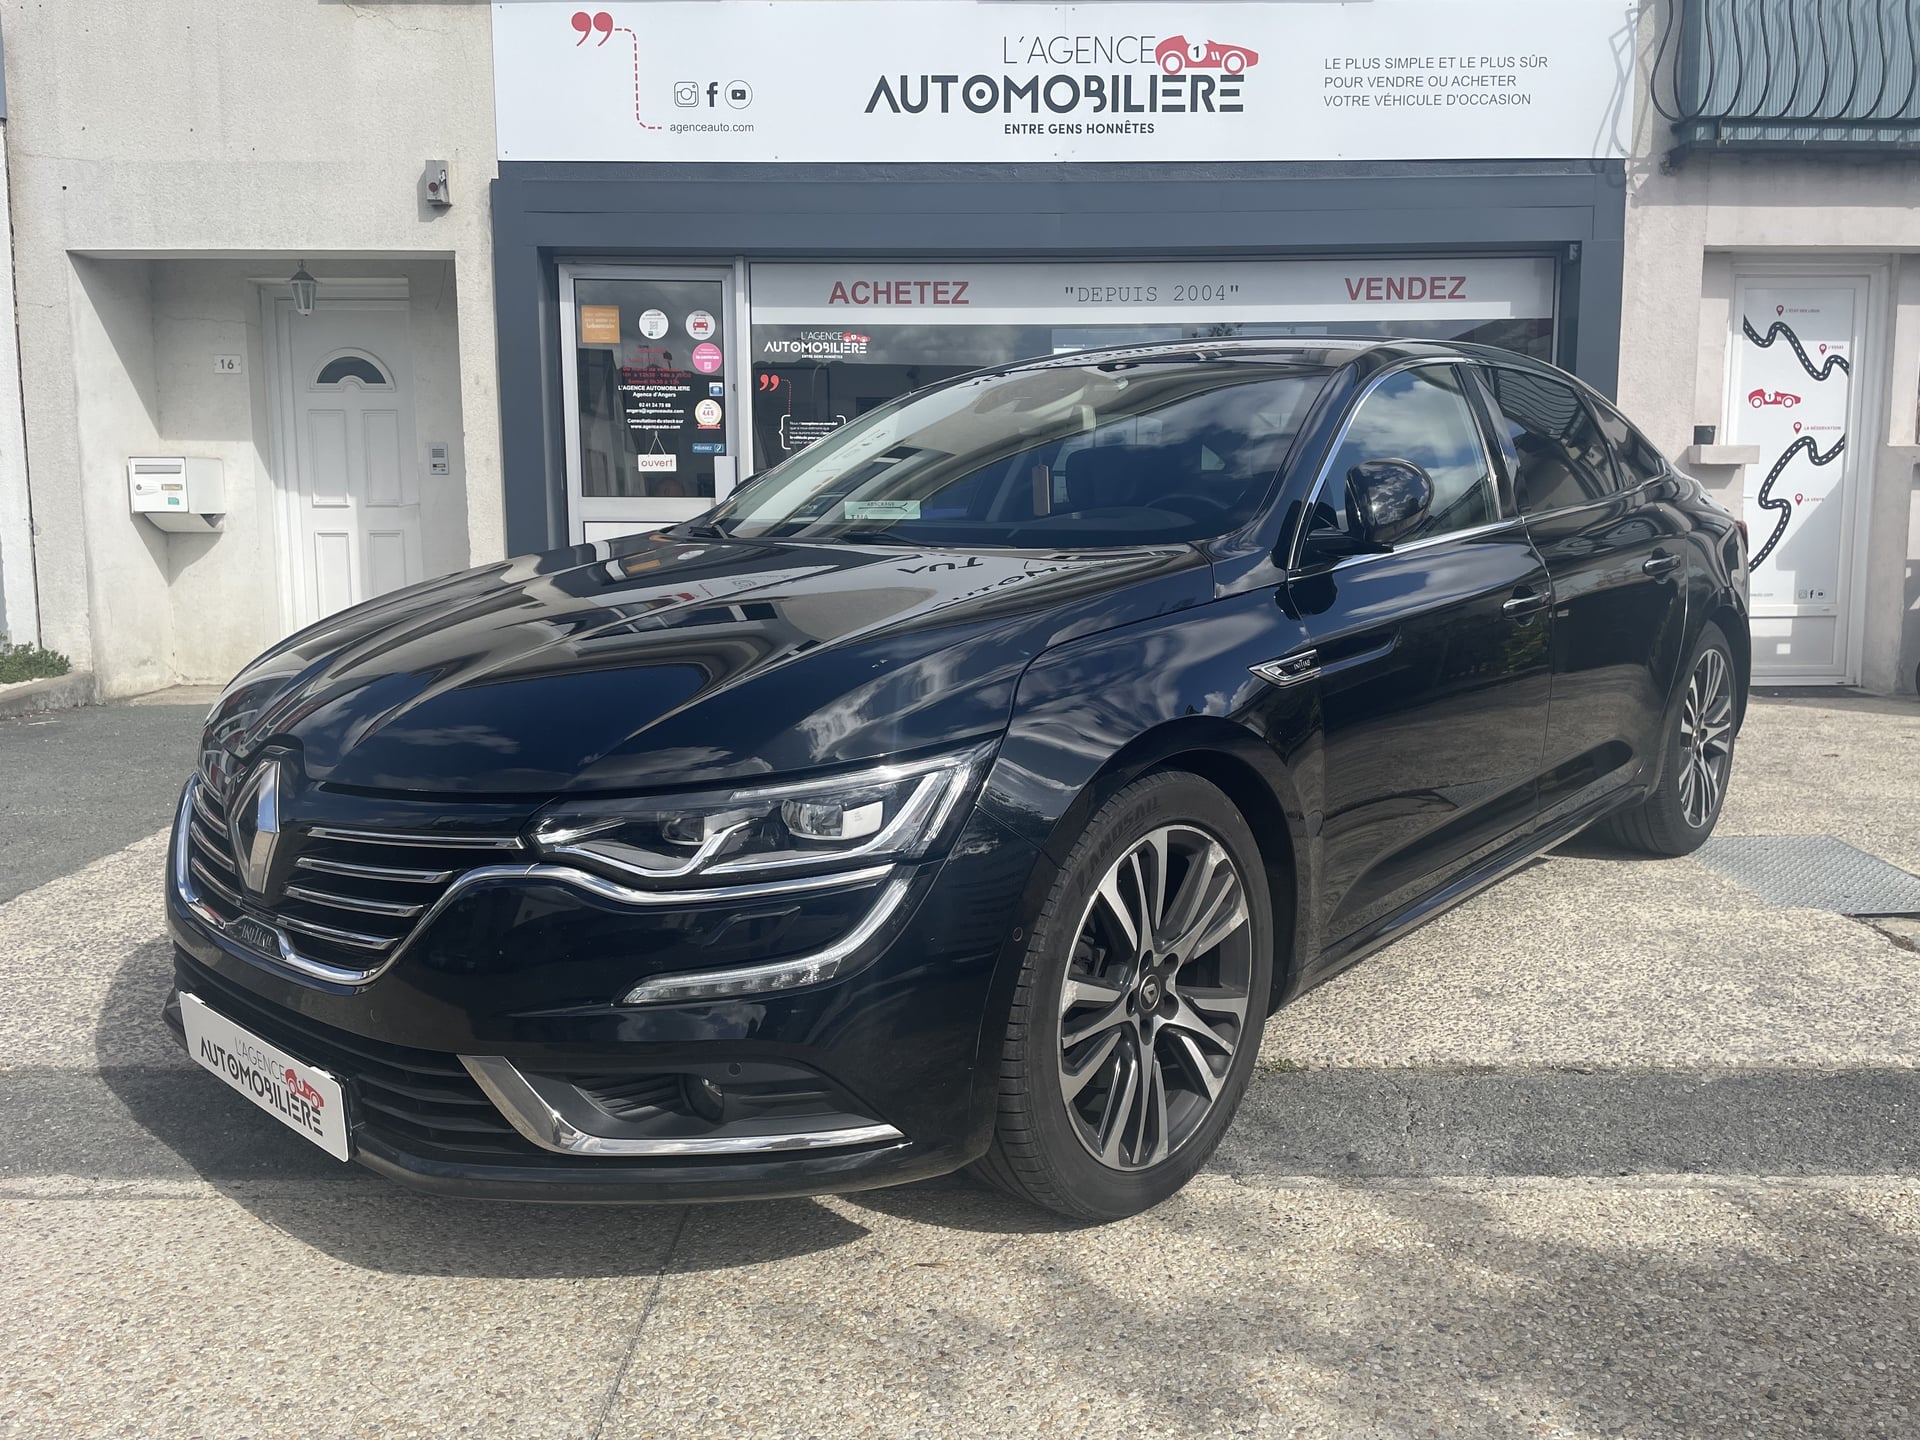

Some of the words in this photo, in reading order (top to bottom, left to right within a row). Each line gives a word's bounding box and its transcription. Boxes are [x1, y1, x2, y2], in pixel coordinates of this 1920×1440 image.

[1003, 35, 1156, 64] L'AGENCE
[1325, 58, 1341, 69] LE
[1346, 58, 1380, 69] PLUS
[1385, 57, 1434, 69] SIMPLE
[1439, 57, 1456, 68] ET
[1460, 57, 1475, 68] LE
[1481, 57, 1515, 68] PLUS
[1520, 54, 1547, 68] SÛR
[1325, 77, 1363, 88] POUR
[1367, 76, 1423, 88] VENDRE
[1428, 76, 1448, 87] OU
[1451, 75, 1516, 87] ACHETER
[1324, 95, 1370, 106] VOTRE
[1374, 93, 1442, 106] VÉHICULE
[1447, 94, 1531, 106] D'OCCASION
[670, 122, 754, 134] agenceauto.com
[1004, 124, 1044, 135] ENTRE
[1048, 124, 1082, 135] GENS
[1087, 121, 1154, 135] HONNÊTES
[829, 280, 969, 304] ACHETEZ
[1065, 286, 1157, 302] "DEPUIS
[1174, 285, 1239, 302] 2004"
[1345, 276, 1467, 301] VENDEZ
[801, 331, 843, 341] L'AGENCE
[220, 358, 234, 369] 16
[641, 458, 673, 468] ouvert
[234, 1035, 288, 1085] L'AGENCE
